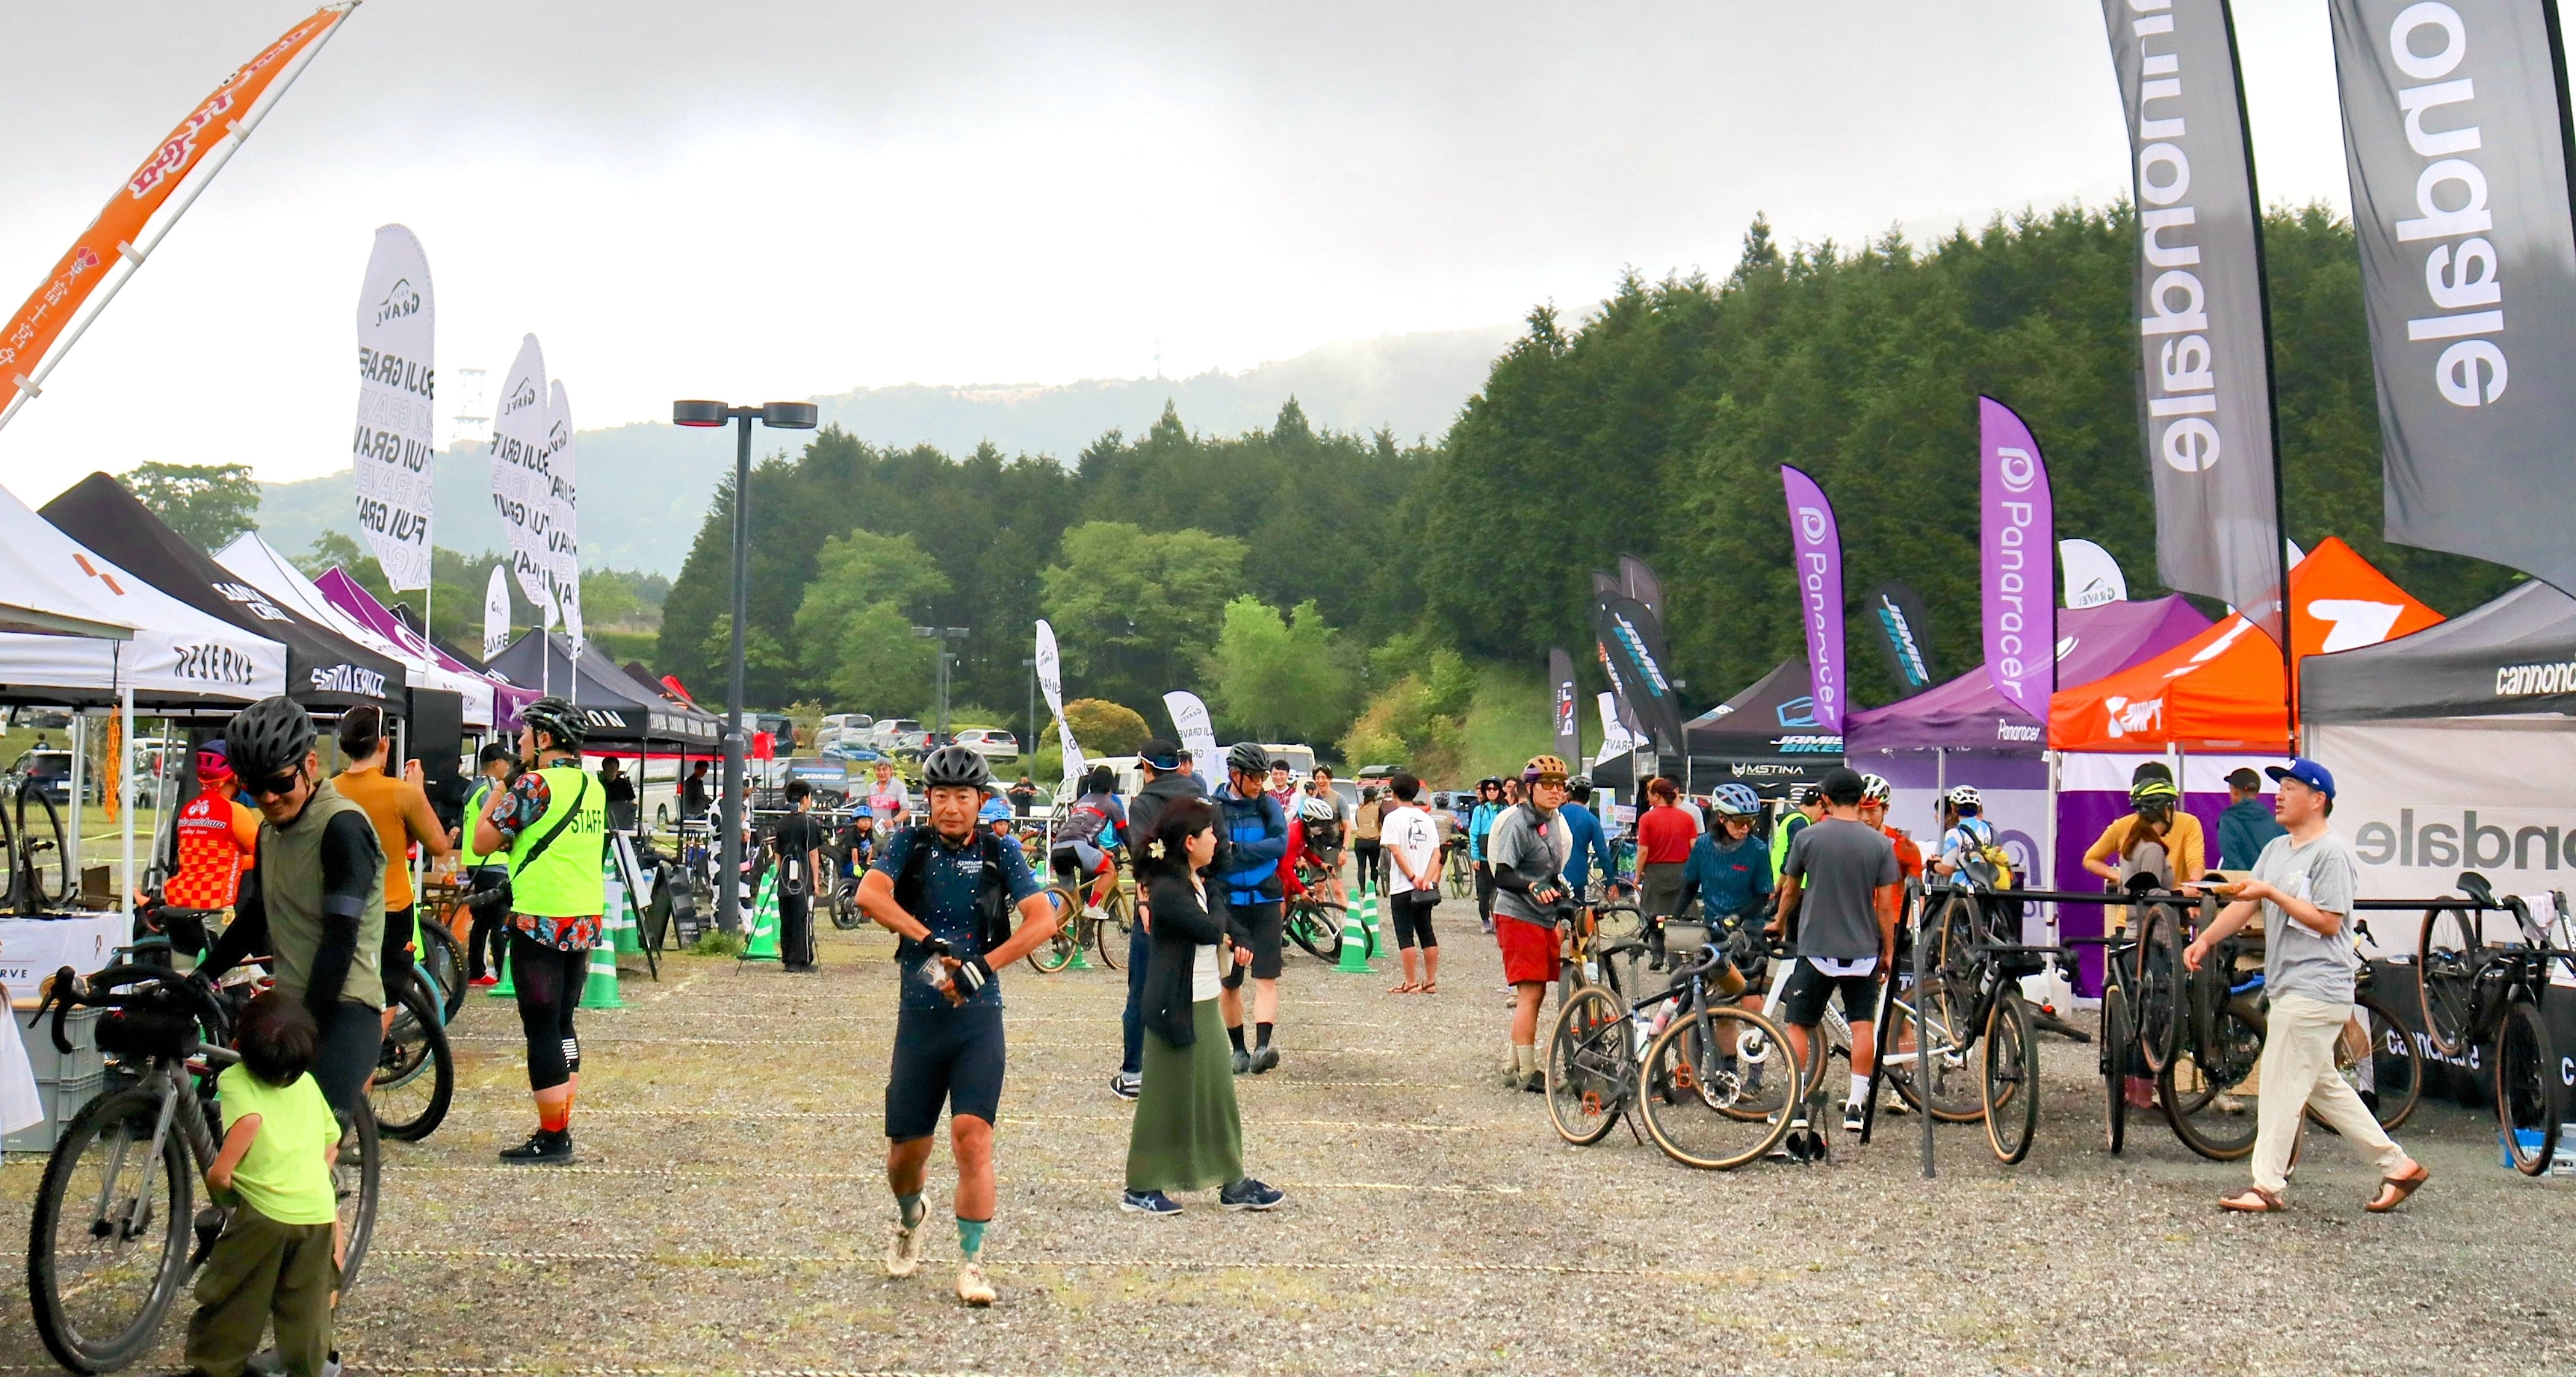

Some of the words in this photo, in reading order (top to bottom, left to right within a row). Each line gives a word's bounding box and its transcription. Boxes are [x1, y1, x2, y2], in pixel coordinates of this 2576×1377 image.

[2001, 501, 2032, 699] Panaracer
[173, 643, 253, 686] RESERVE
[1613, 627, 1663, 697] BIKES
[1615, 612, 1670, 692] JAMIS
[1878, 608, 1922, 686] BIKES
[1882, 594, 1930, 683] JAMIS
[1770, 736, 1843, 745] JAMIS
[1998, 718, 2040, 741] Panaracer
[571, 809, 601, 834] STAFF
